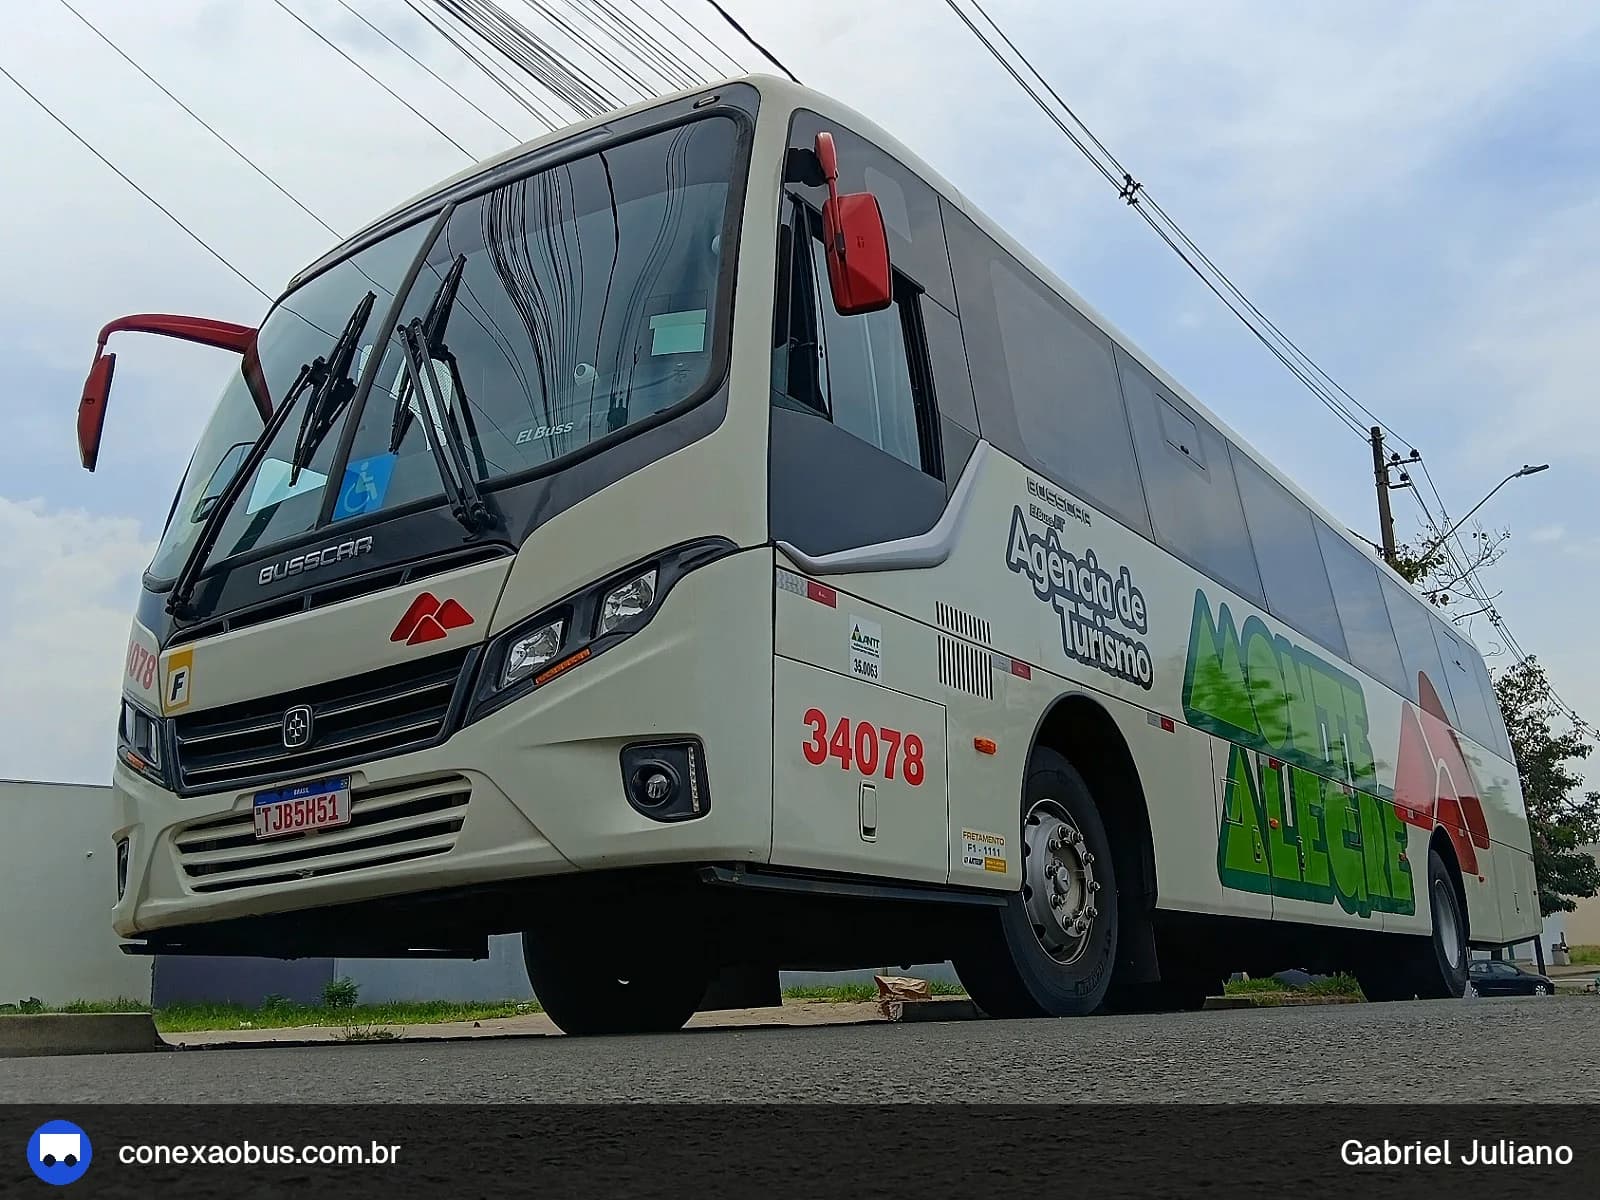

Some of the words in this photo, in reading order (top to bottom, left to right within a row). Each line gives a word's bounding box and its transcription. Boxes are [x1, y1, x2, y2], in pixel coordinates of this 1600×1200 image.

[258, 536, 373, 585] BUSSCAR
[1007, 505, 1116, 614] Agência
[1114, 567, 1147, 634] de
[127, 641, 157, 690] 078
[1052, 594, 1153, 690] Turismo
[170, 671, 186, 702] F
[802, 707, 925, 786] 34078
[262, 794, 339, 833] TJB5H51
